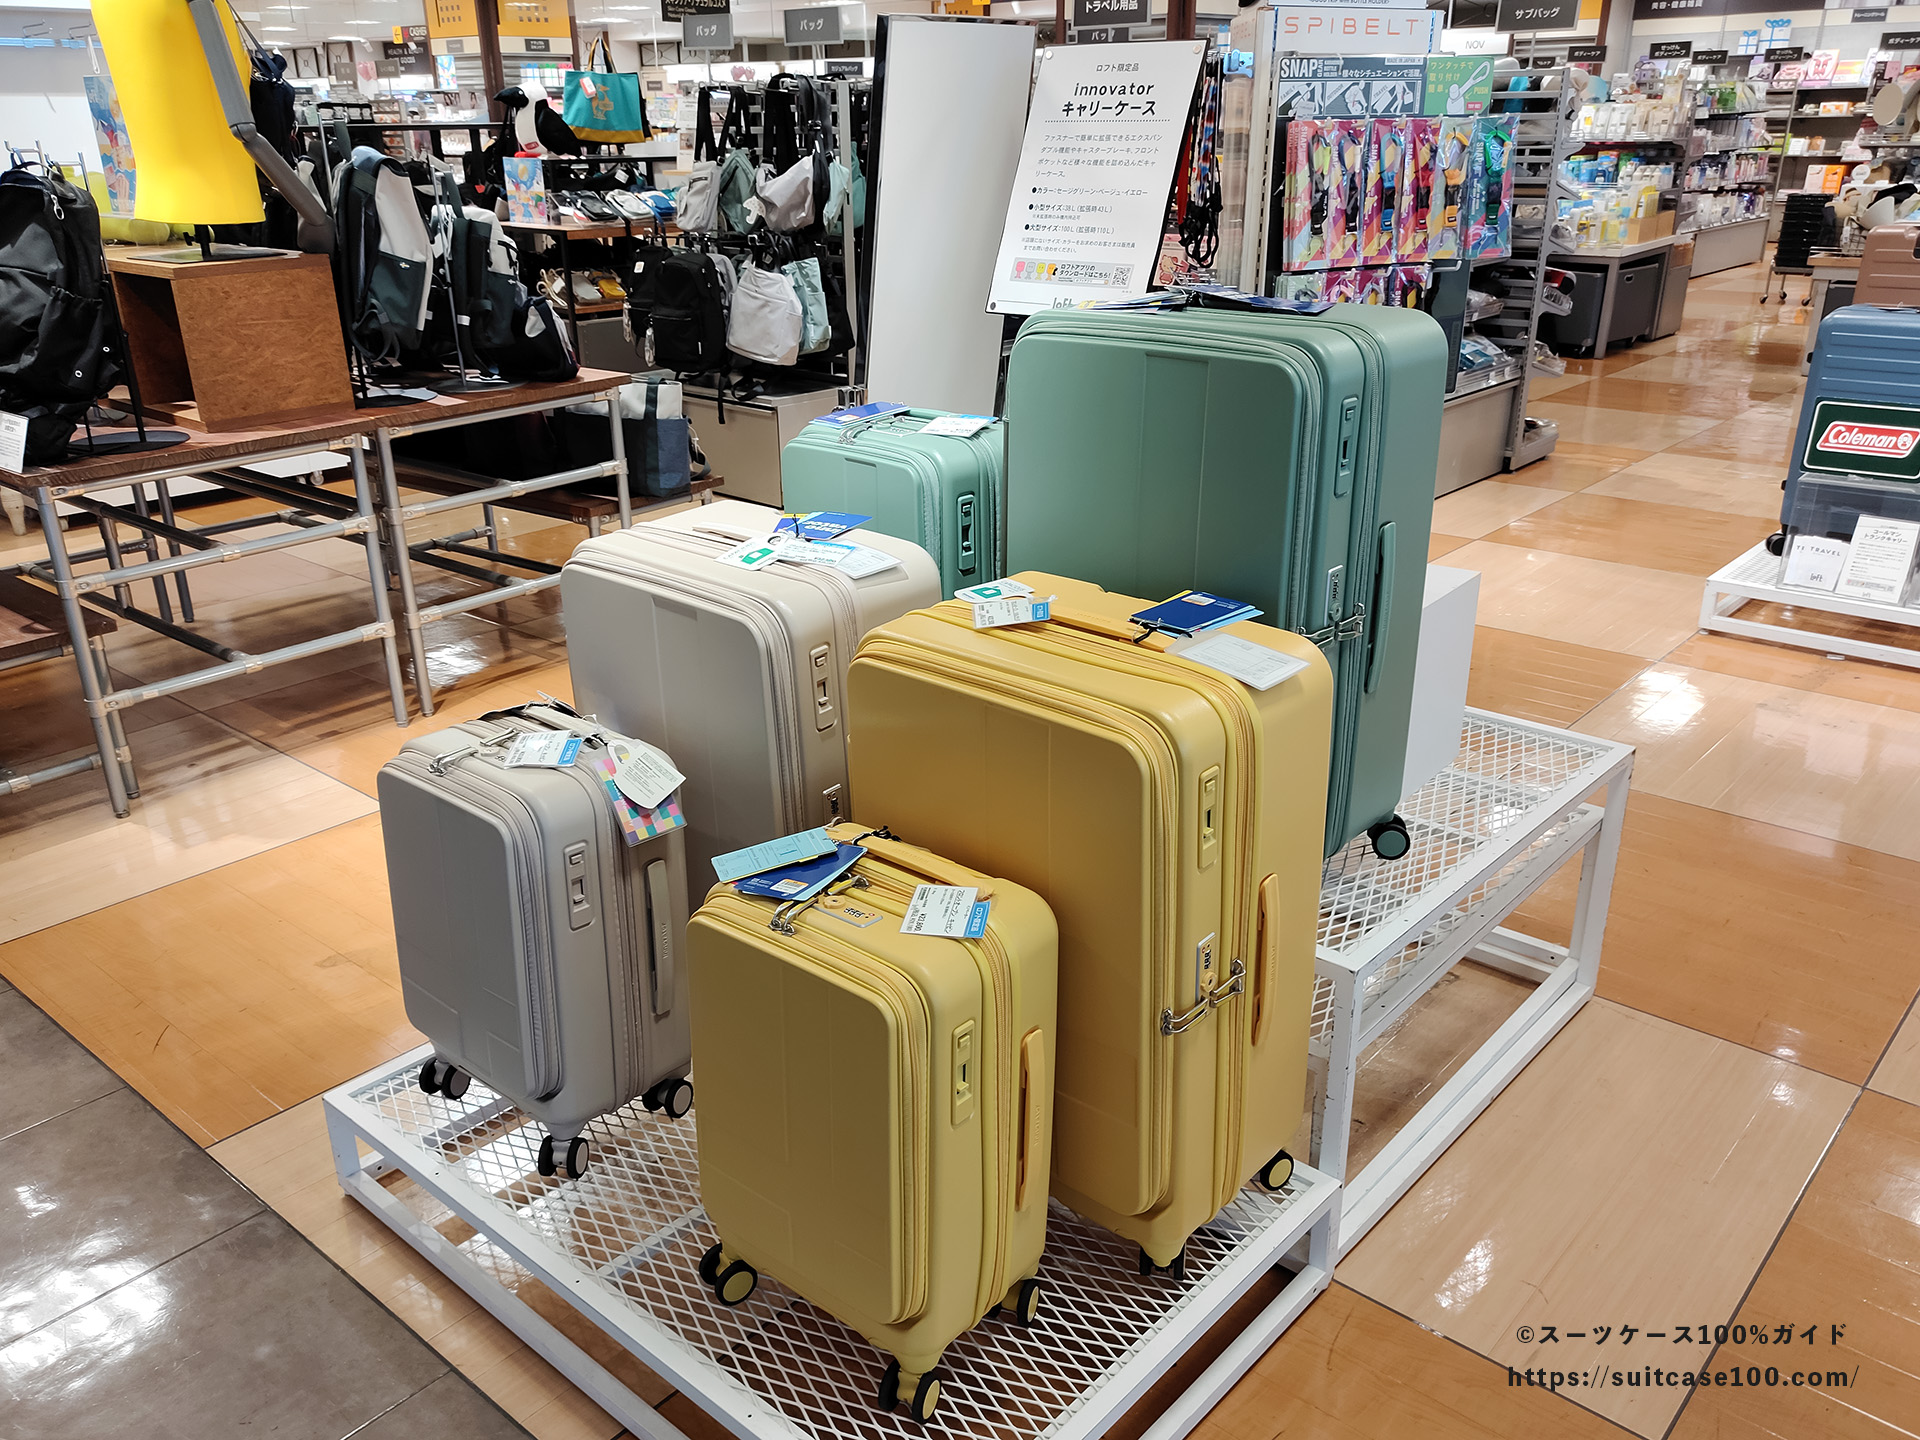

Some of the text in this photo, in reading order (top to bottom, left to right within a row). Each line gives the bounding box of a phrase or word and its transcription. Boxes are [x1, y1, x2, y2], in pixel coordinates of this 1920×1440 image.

[1086, 0, 1138, 13] トラベル用品
[1515, 7, 1560, 19] サブバッグ
[798, 18, 824, 31] バッグ
[1284, 17, 1419, 36] SPIBELT
[696, 25, 717, 36] バッグ
[1465, 40, 1485, 49] NOV
[1096, 63, 1139, 72] ロフト限定品
[1281, 59, 1317, 78] SNAP
[1431, 62, 1474, 70] ワンタッチで
[1074, 83, 1154, 96] innovator
[1062, 101, 1156, 117] キャリーケース
[1829, 426, 1897, 448] Coleman
[1864, 533, 1908, 543] トランクキャリー
[1874, 529, 1902, 537] コールマン
[1811, 546, 1841, 557] TRAVEL
[1810, 573, 1823, 582] loft
